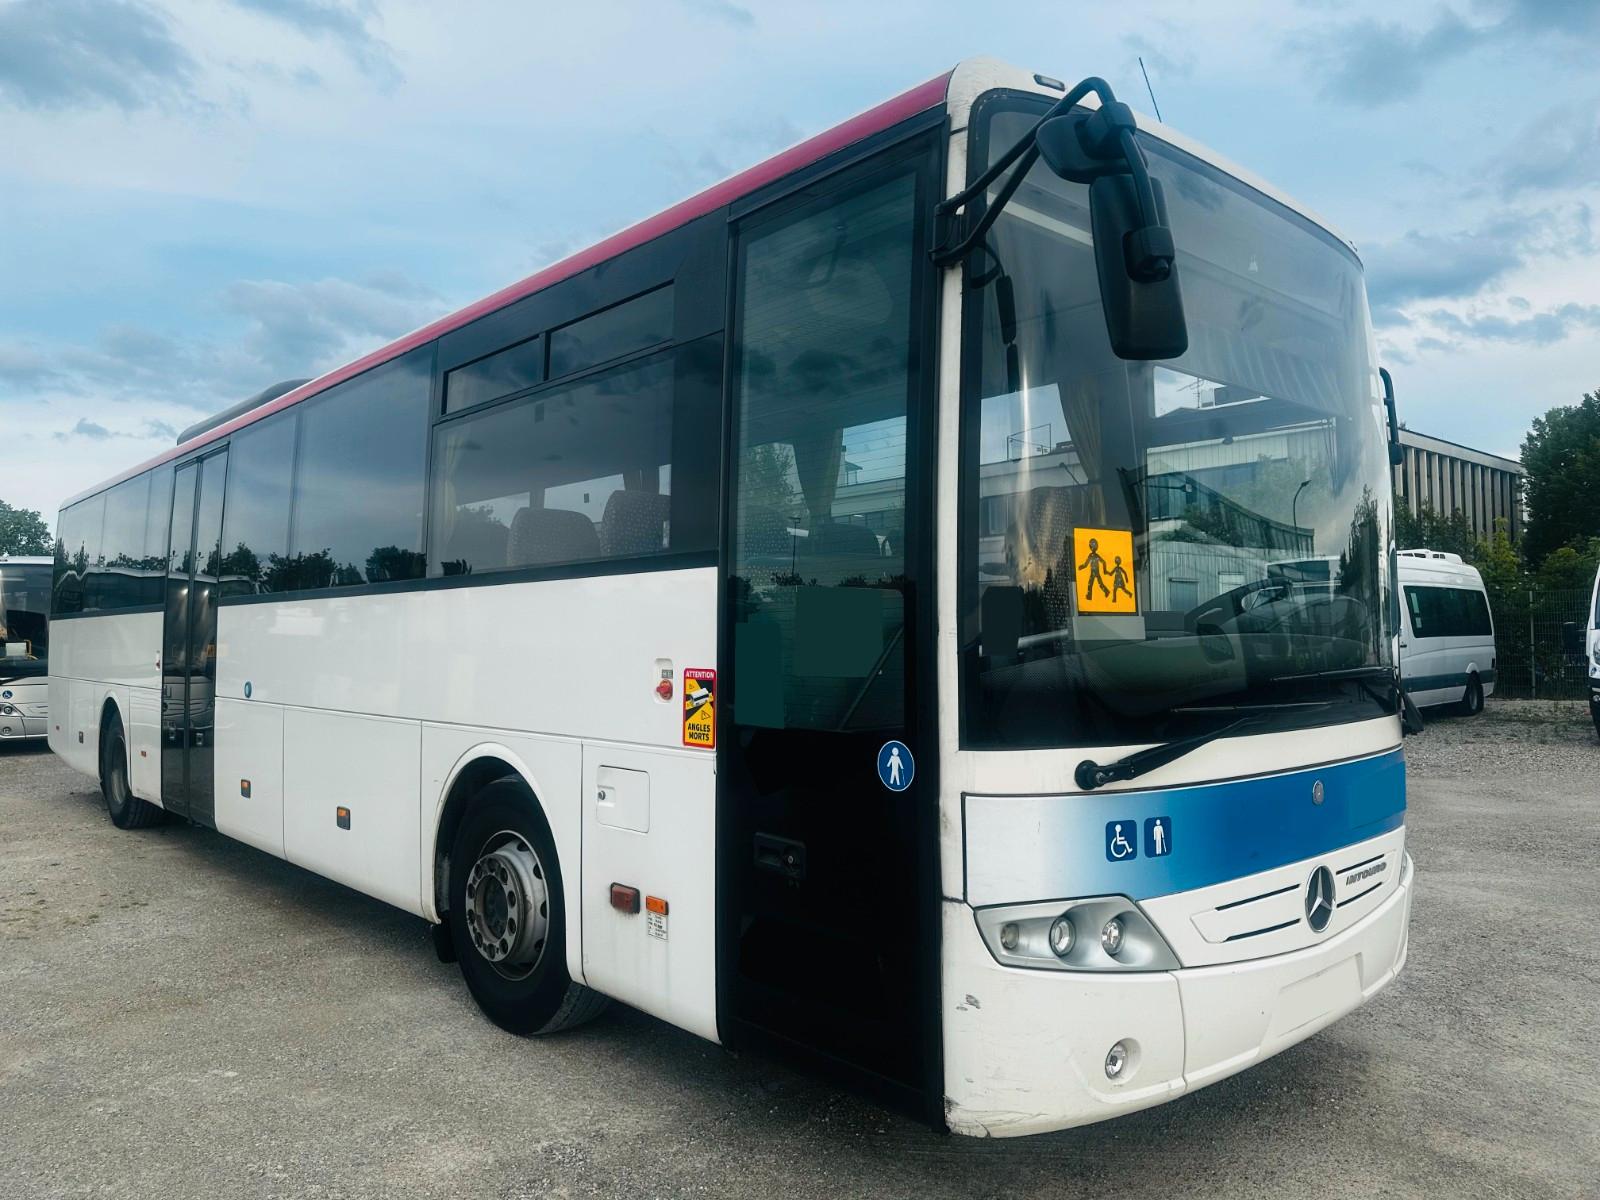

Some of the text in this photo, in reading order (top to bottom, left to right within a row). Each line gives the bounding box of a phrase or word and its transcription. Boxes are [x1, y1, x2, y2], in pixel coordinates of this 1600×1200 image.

[686, 671, 714, 679] ATTENTION
[688, 723, 710, 732] ANGLES
[689, 732, 710, 741] MORTS
